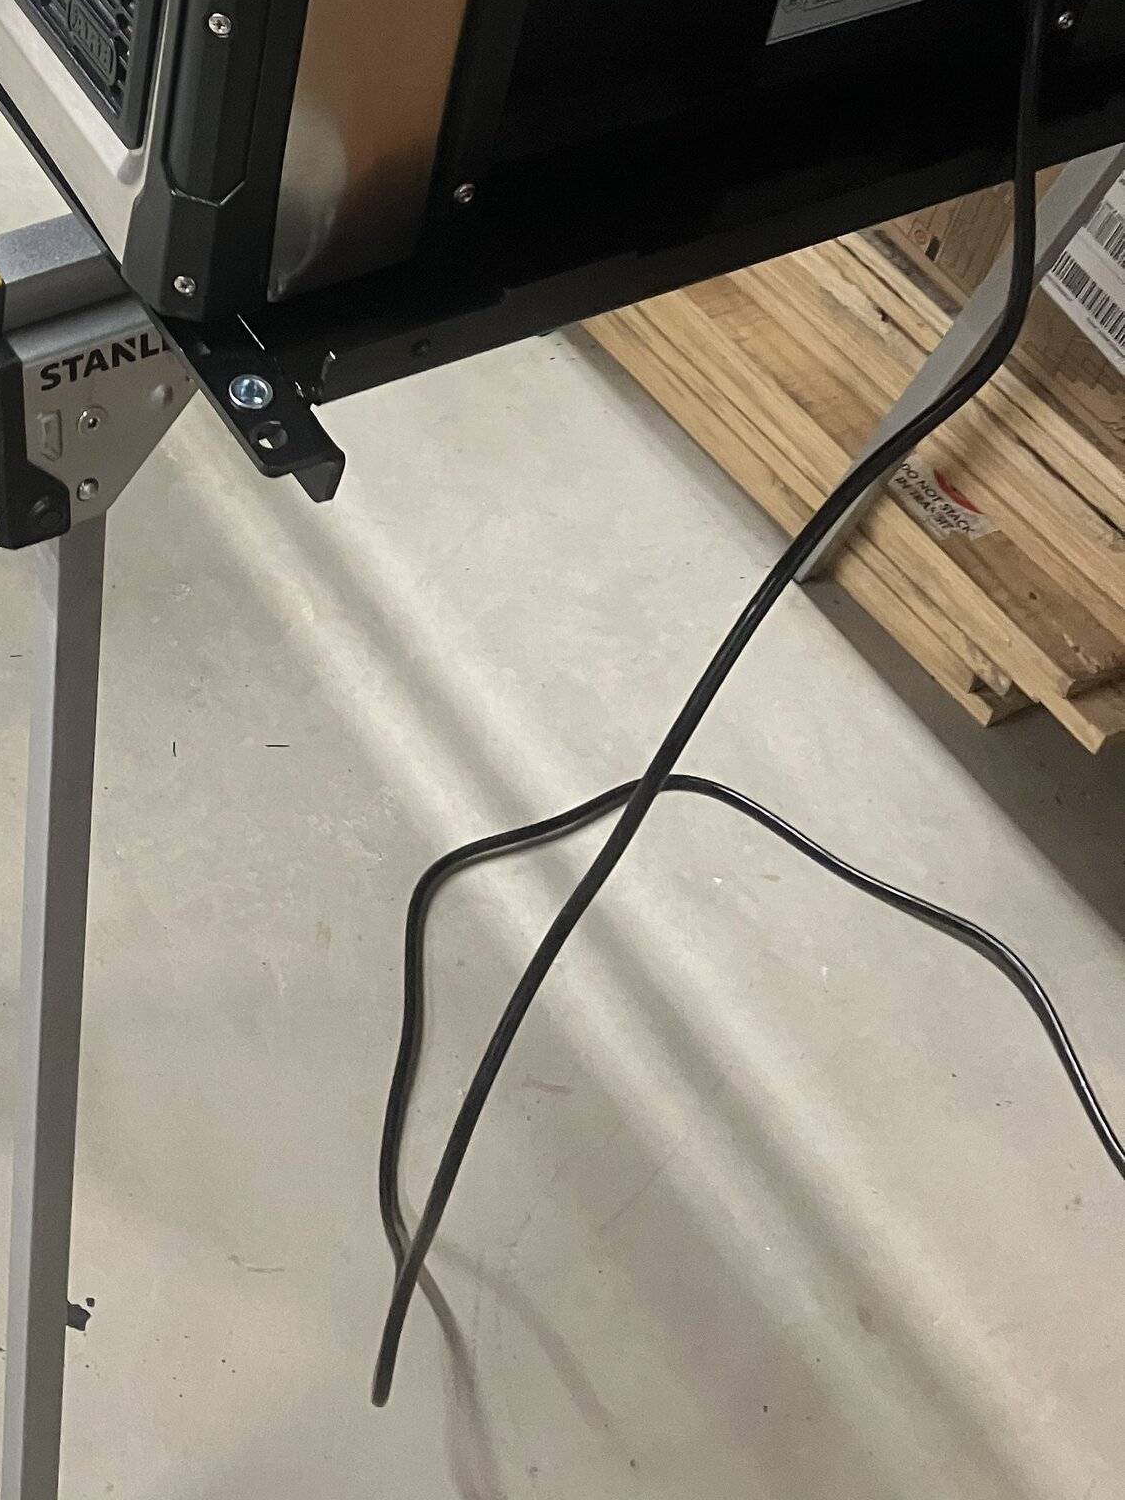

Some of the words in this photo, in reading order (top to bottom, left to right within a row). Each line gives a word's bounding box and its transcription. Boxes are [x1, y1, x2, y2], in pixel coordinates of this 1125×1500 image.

[895, 477, 911, 489] IN
[899, 463, 919, 480] DO
[916, 480, 945, 502] NOT
[941, 503, 976, 533] STACK
